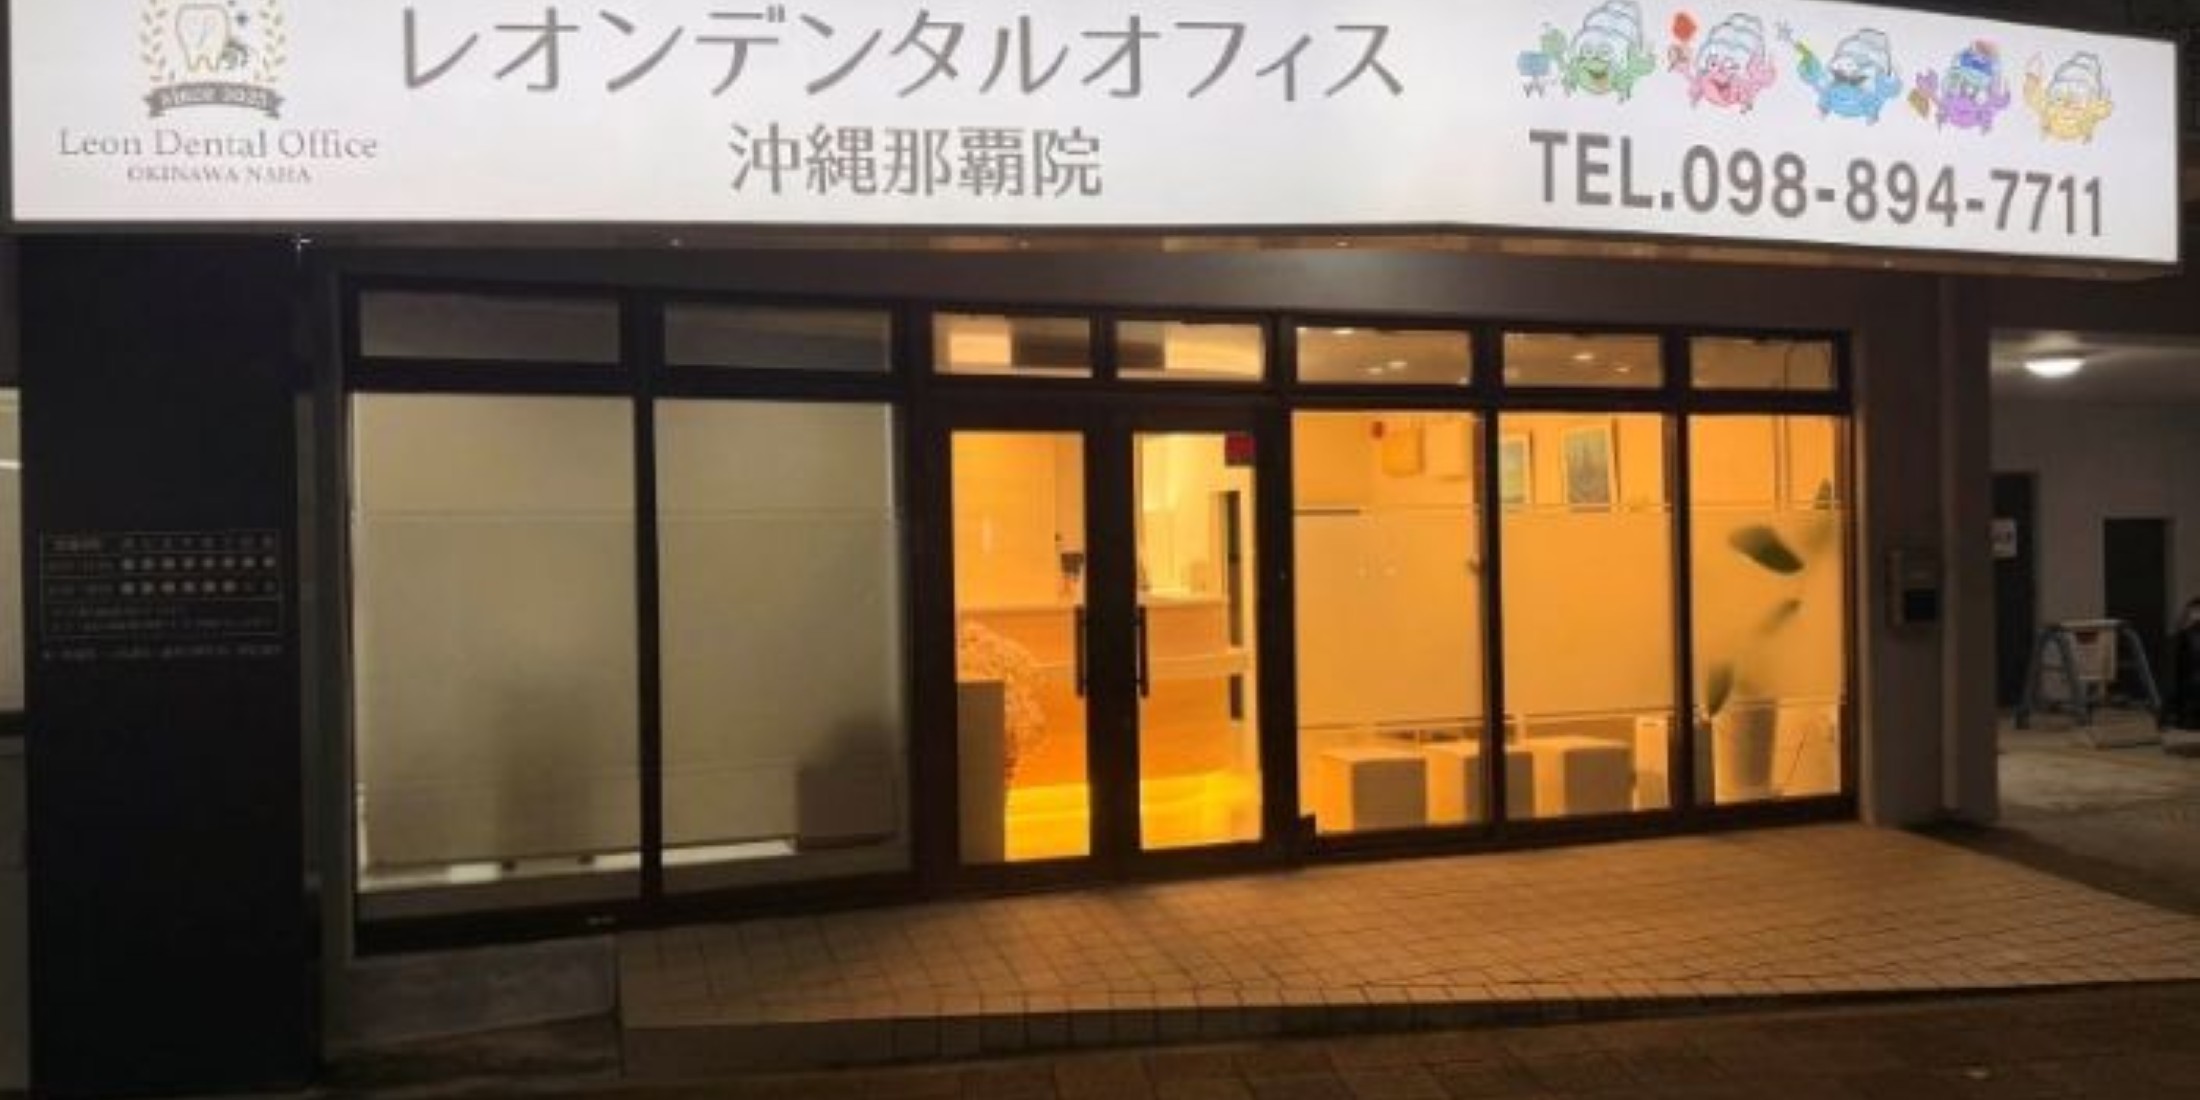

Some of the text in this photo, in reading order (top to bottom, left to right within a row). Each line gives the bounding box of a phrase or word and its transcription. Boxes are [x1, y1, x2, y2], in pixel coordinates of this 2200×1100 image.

[402, 5, 1404, 101] レオンデンタルオフィス
[58, 128, 378, 159] Leon Dental Office
[127, 166, 312, 184] OKINAWA NAHA
[728, 122, 1103, 198] 沖縄那覇院
[1529, 129, 2103, 237] TEL.098-894-7711
